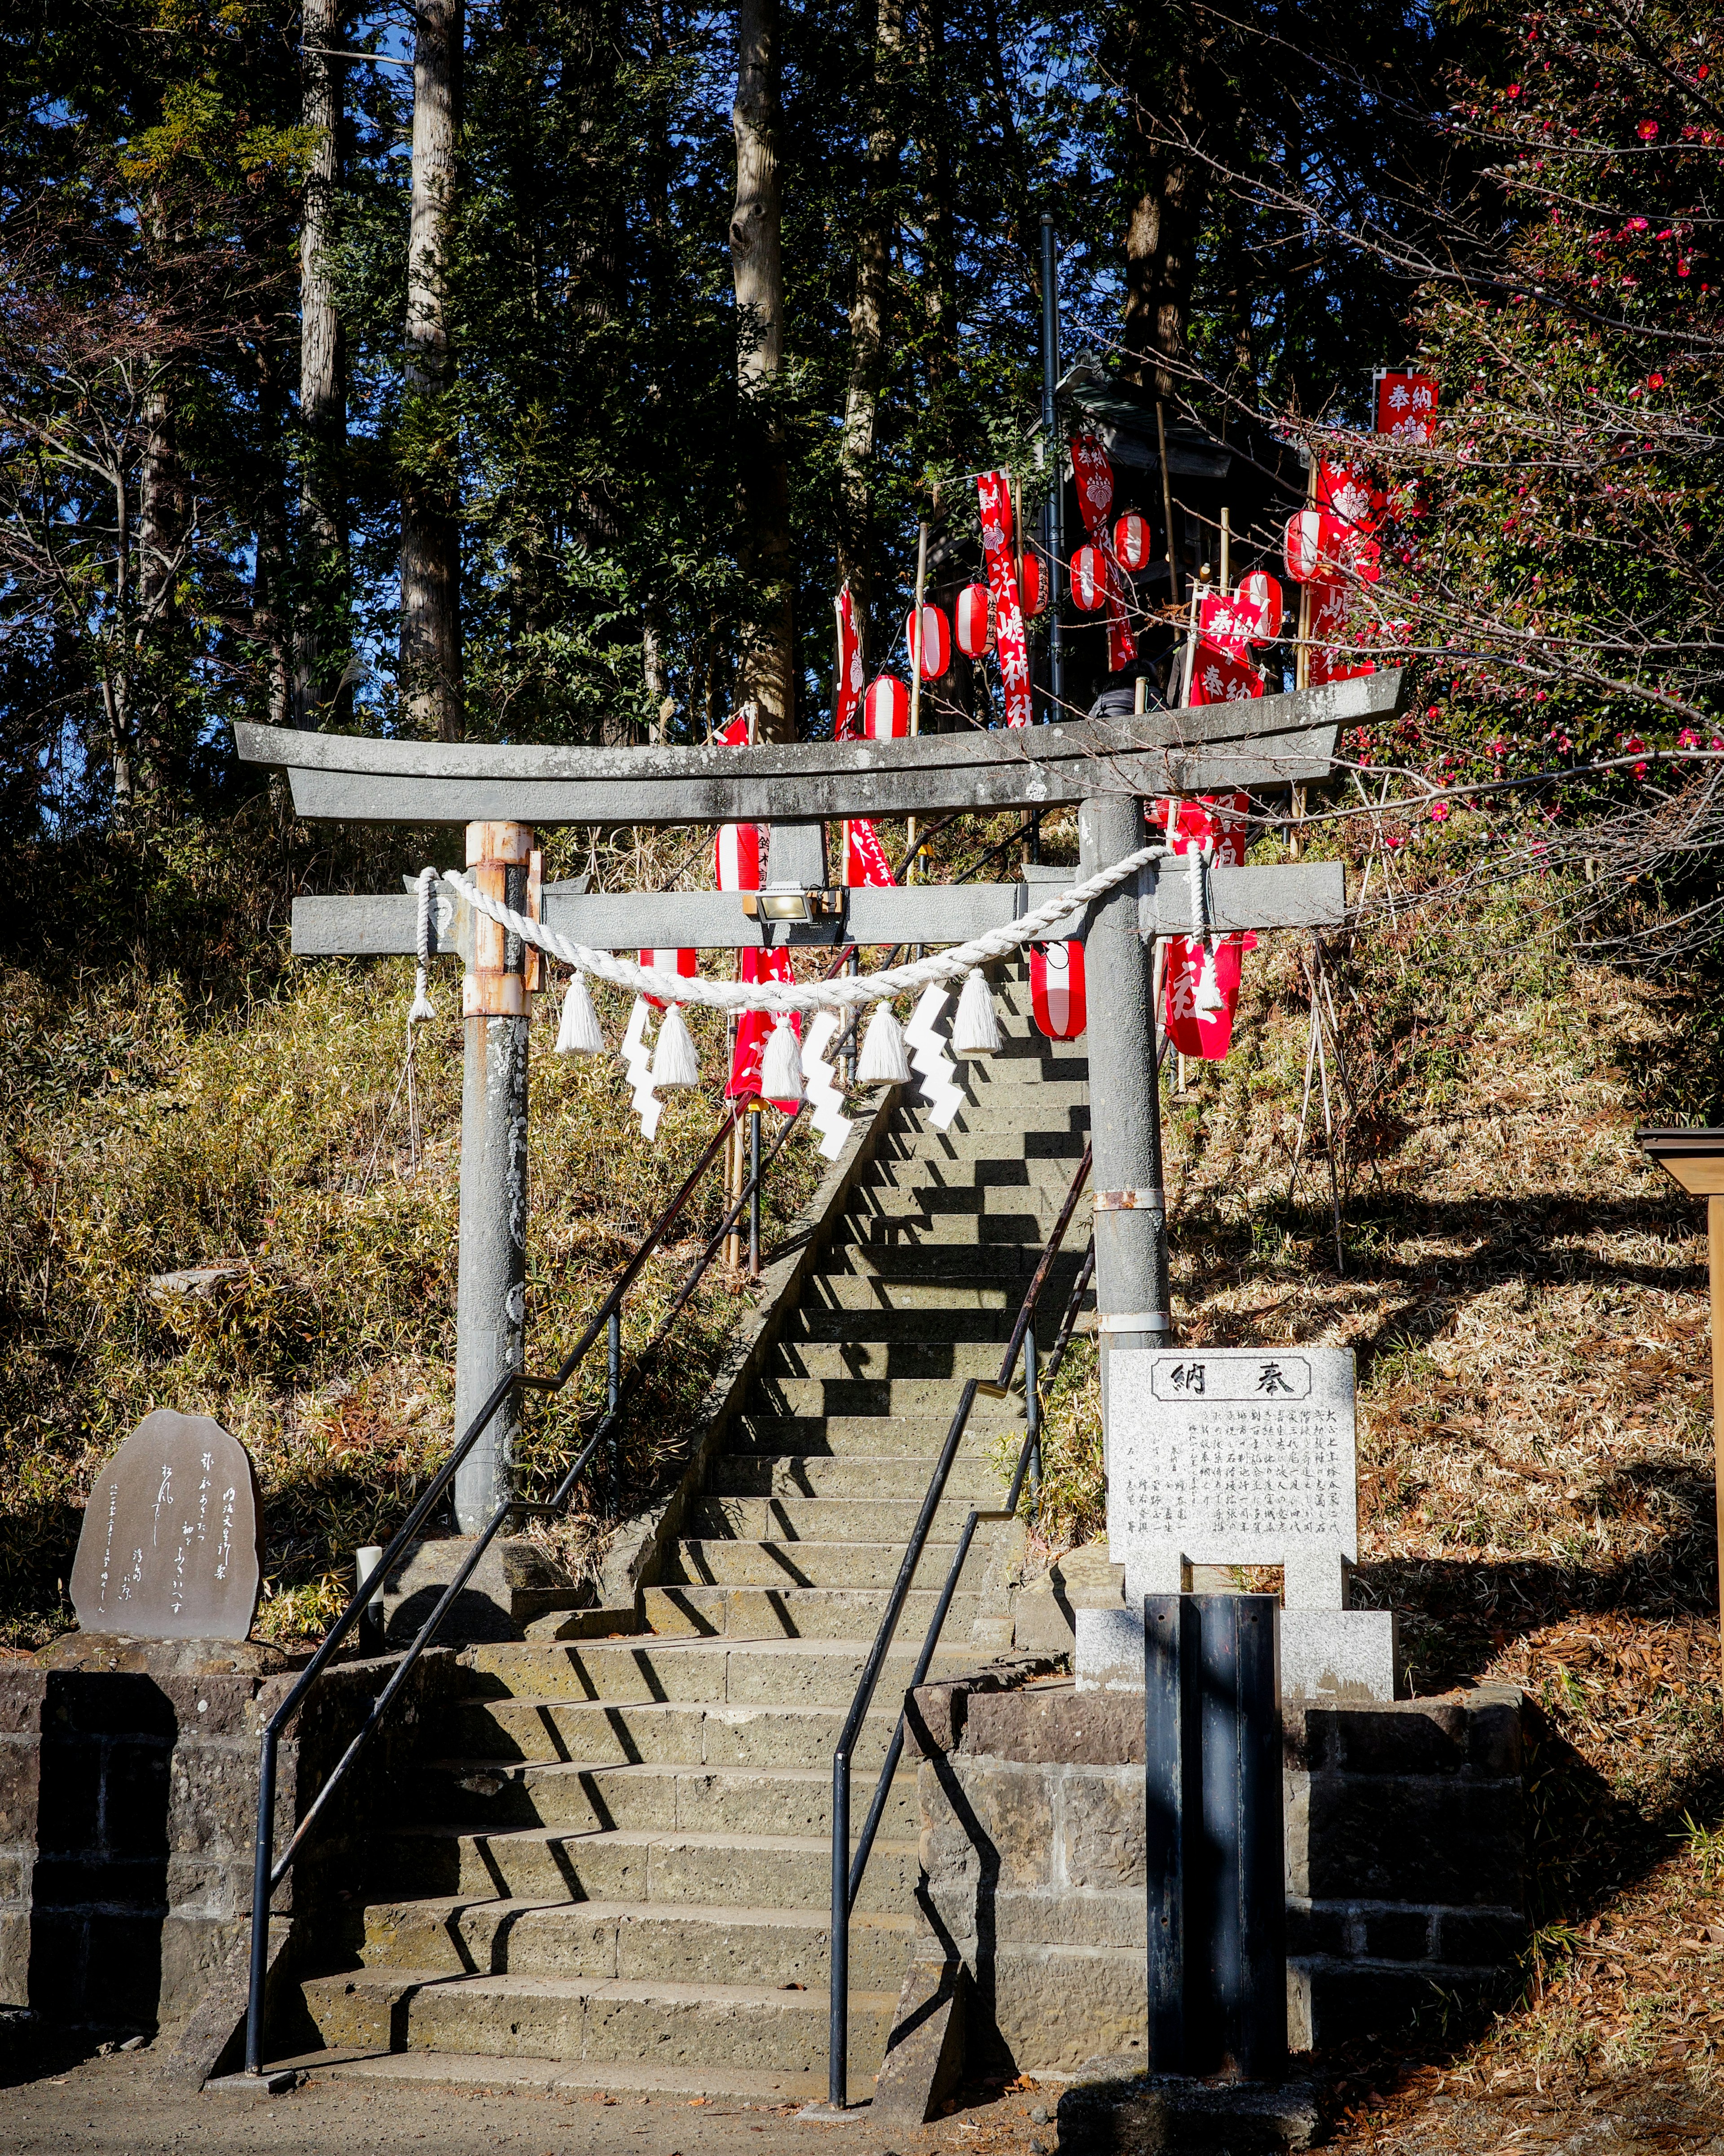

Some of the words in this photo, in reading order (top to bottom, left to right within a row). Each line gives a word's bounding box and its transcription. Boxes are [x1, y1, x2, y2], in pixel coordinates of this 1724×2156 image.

[1388, 384, 1432, 412] 奉納
[1078, 447, 1107, 469] 奉納
[1201, 664, 1252, 702] 奉納
